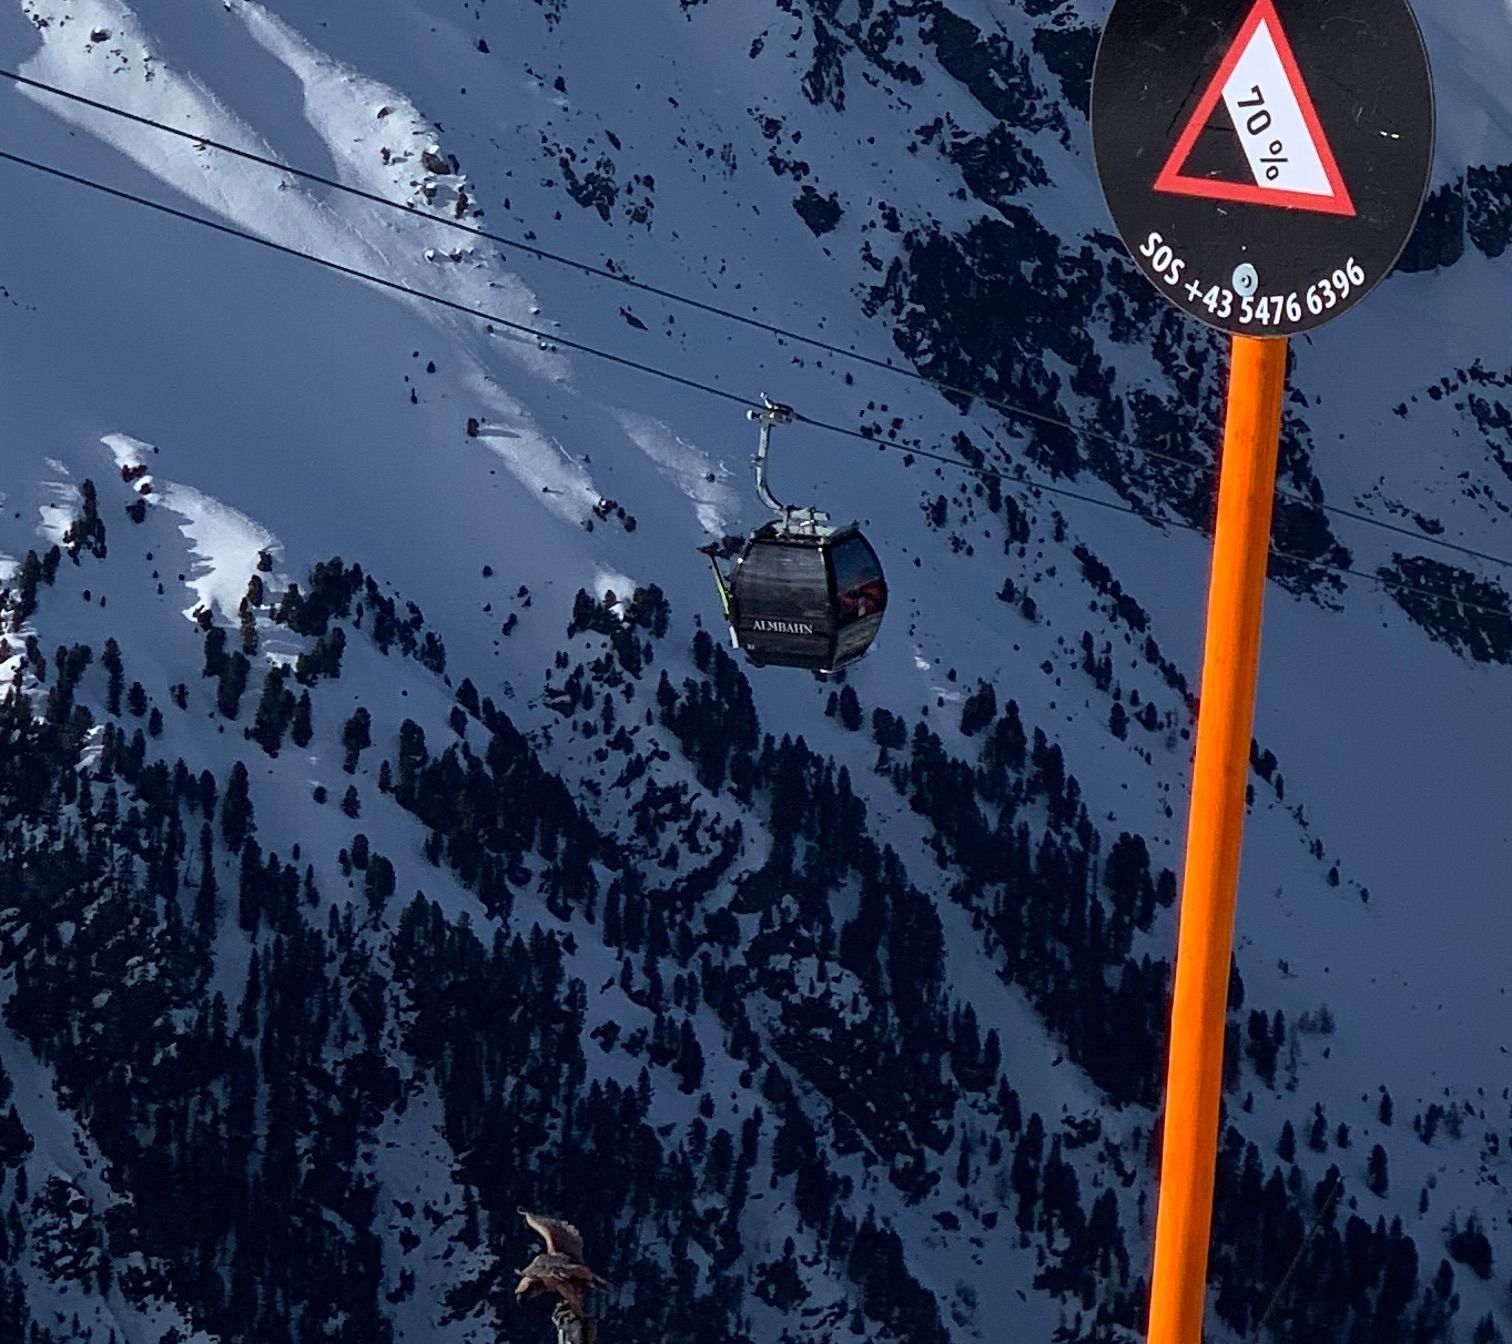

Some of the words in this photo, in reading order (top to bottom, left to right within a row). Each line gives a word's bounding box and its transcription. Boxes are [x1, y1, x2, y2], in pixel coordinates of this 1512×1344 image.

[1139, 231, 1187, 285] SOS
[1184, 280, 1233, 319] +43
[1238, 291, 1302, 325] 5476
[1306, 257, 1365, 316] 6396
[753, 620, 813, 635] ALMBAHN
